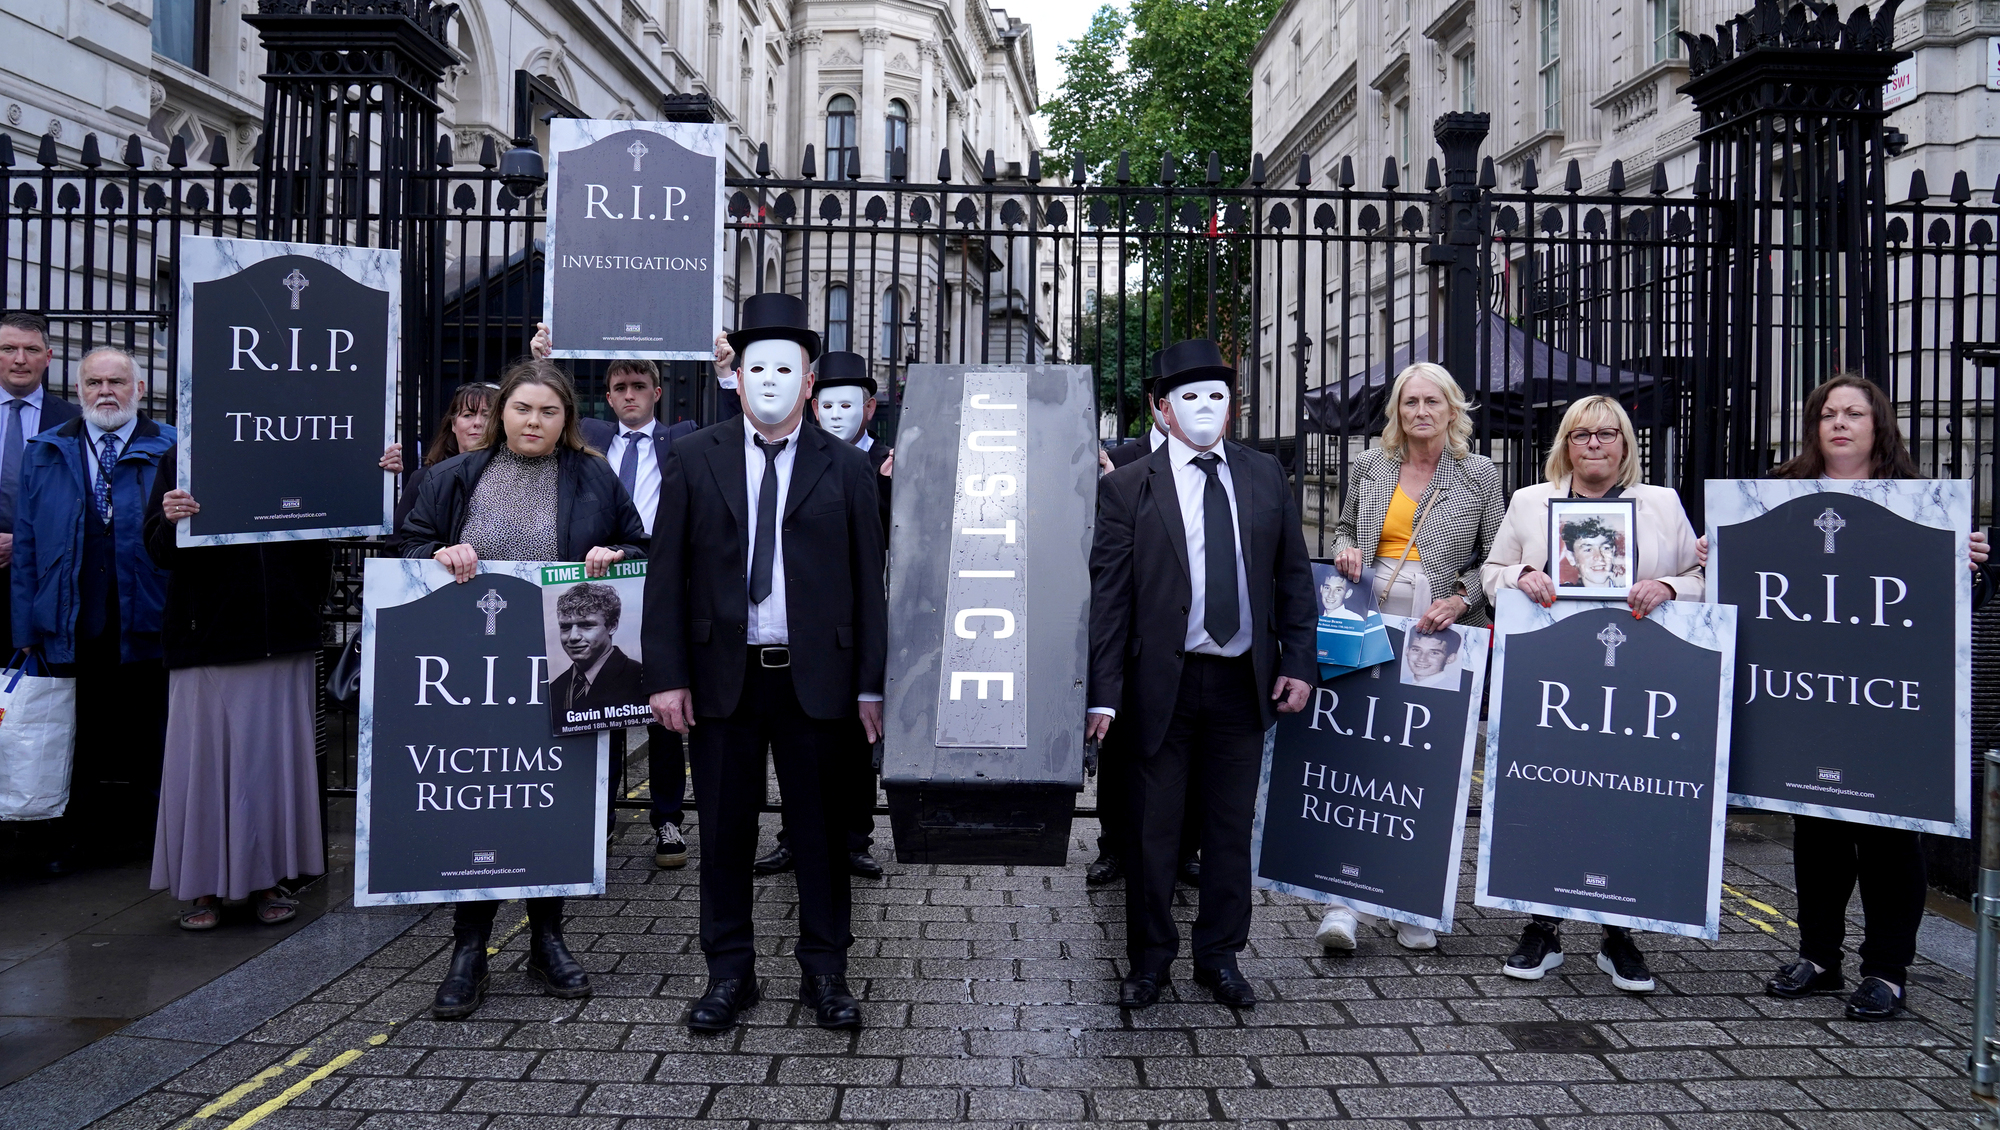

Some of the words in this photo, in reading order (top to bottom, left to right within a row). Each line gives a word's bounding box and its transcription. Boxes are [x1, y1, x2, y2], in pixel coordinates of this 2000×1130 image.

[1892, 73, 1910, 91] SW1
[584, 183, 690, 221] R.I.P.
[562, 255, 707, 271] INVESTIGATIONS
[229, 325, 358, 371] R.I.P.
[254, 511, 327, 521] www.relativesforjustice.com
[949, 393, 1018, 702] JUSTICE
[545, 566, 580, 582] TIME
[614, 561, 649, 576] TRUT
[1754, 571, 1913, 628] R.I.P.
[566, 708, 601, 723] Gavin
[604, 703, 652, 719] McShan
[1308, 687, 1432, 751] R.I.P.
[1536, 679, 1681, 741] R.I.P.
[562, 724, 592, 733] Murdered
[593, 722, 609, 730] 18th.
[624, 718, 641, 726] 1994.
[1785, 782, 1875, 799] www.relativesforjustice.com
[440, 867, 526, 877] www.relativesforjustice.com
[1314, 873, 1384, 894] www.relativesforjustice.com
[1553, 886, 1637, 903] www.relativesforjustice.com
